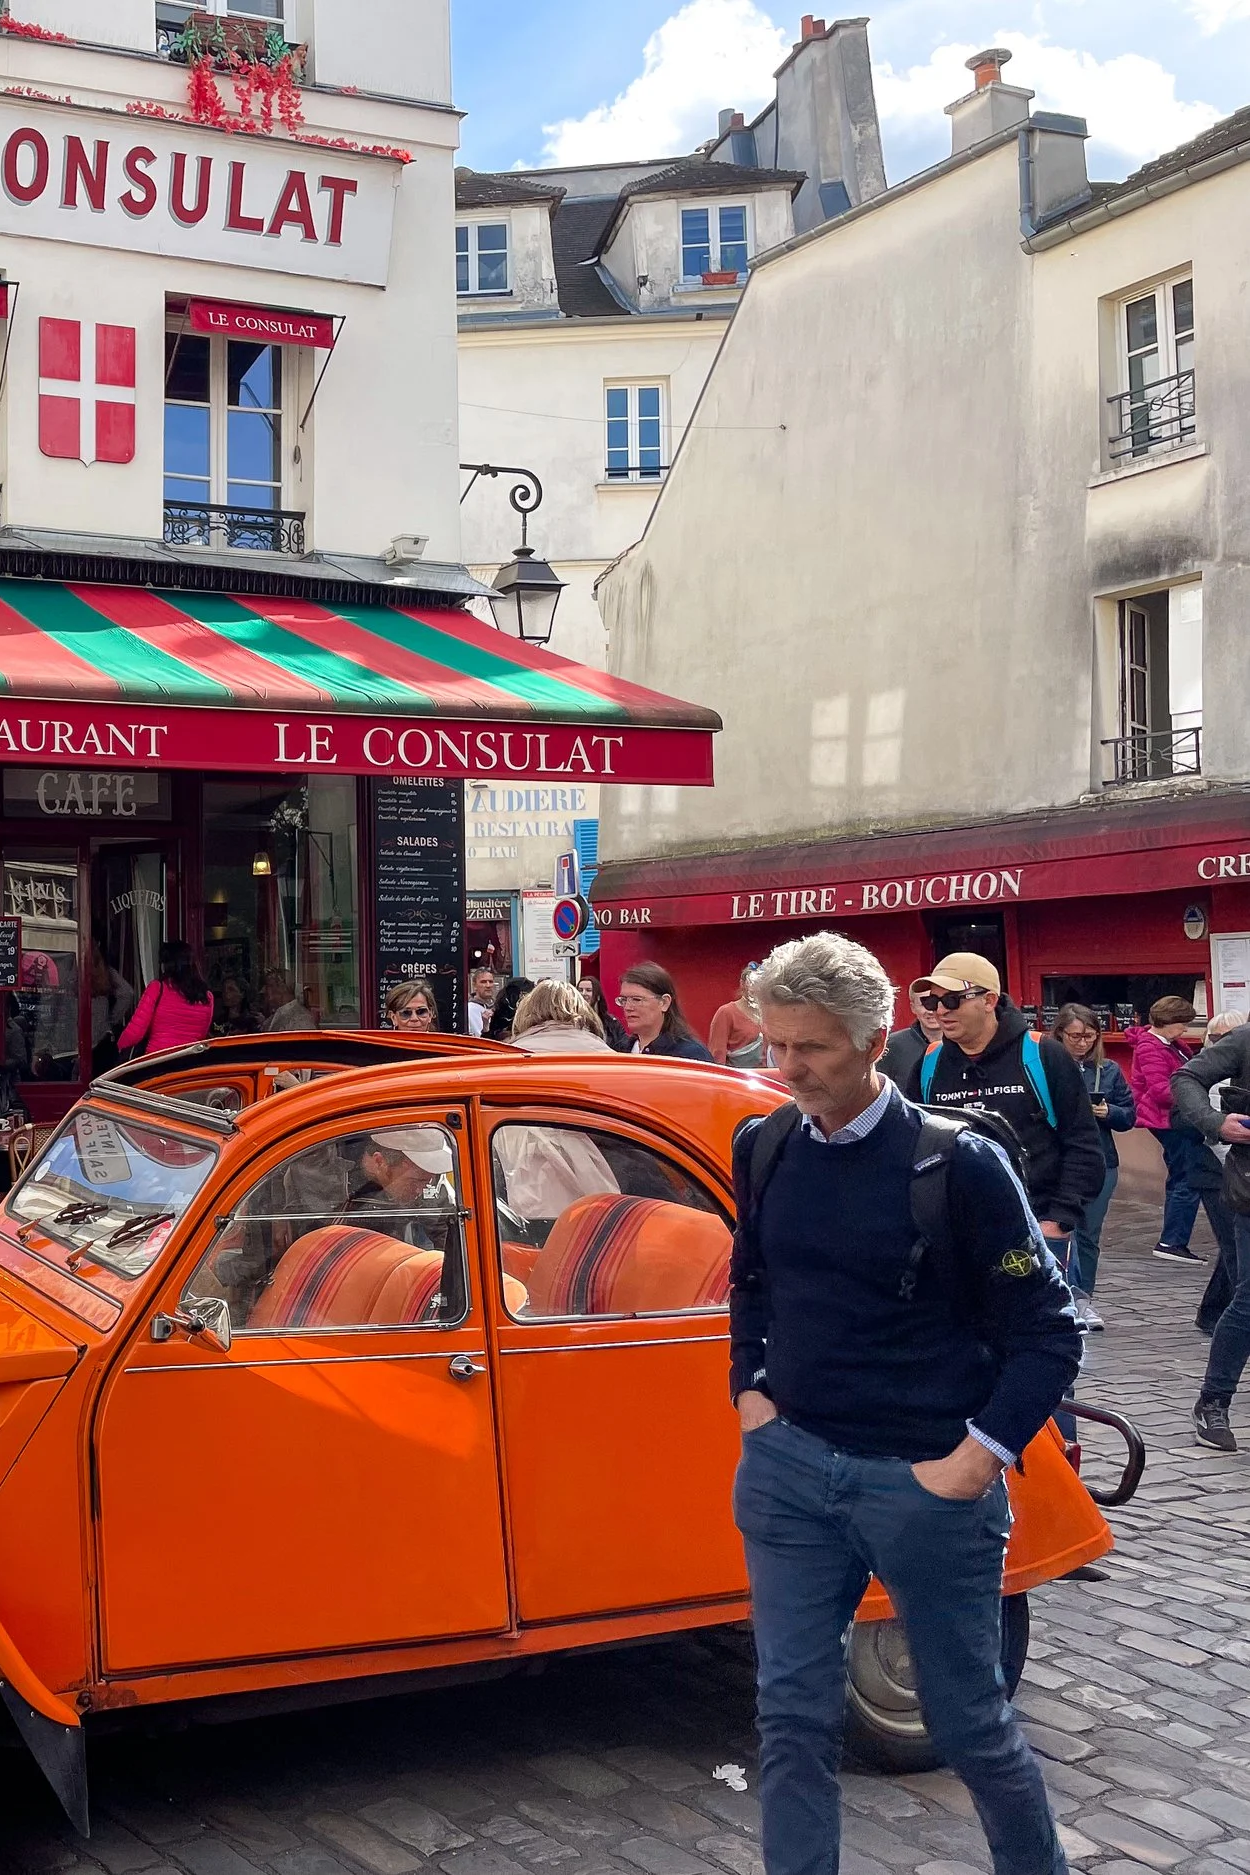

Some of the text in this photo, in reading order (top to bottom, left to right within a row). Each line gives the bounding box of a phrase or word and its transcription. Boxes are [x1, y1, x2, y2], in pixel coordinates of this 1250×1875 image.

[208, 311, 318, 339] LE CONSULAT
[273, 722, 623, 774] LE CONSULAT
[393, 776, 444, 787] OMELETTES
[397, 836, 438, 847] SALADES
[110, 889, 166, 915] LIQUEURS
[730, 894, 765, 920] LE
[771, 887, 838, 916] TIRE
[860, 869, 1024, 911] BOUCHON
[619, 907, 651, 924] BAR
[401, 962, 437, 974] CRÊPES
[936, 1091, 967, 1101] TOMMY
